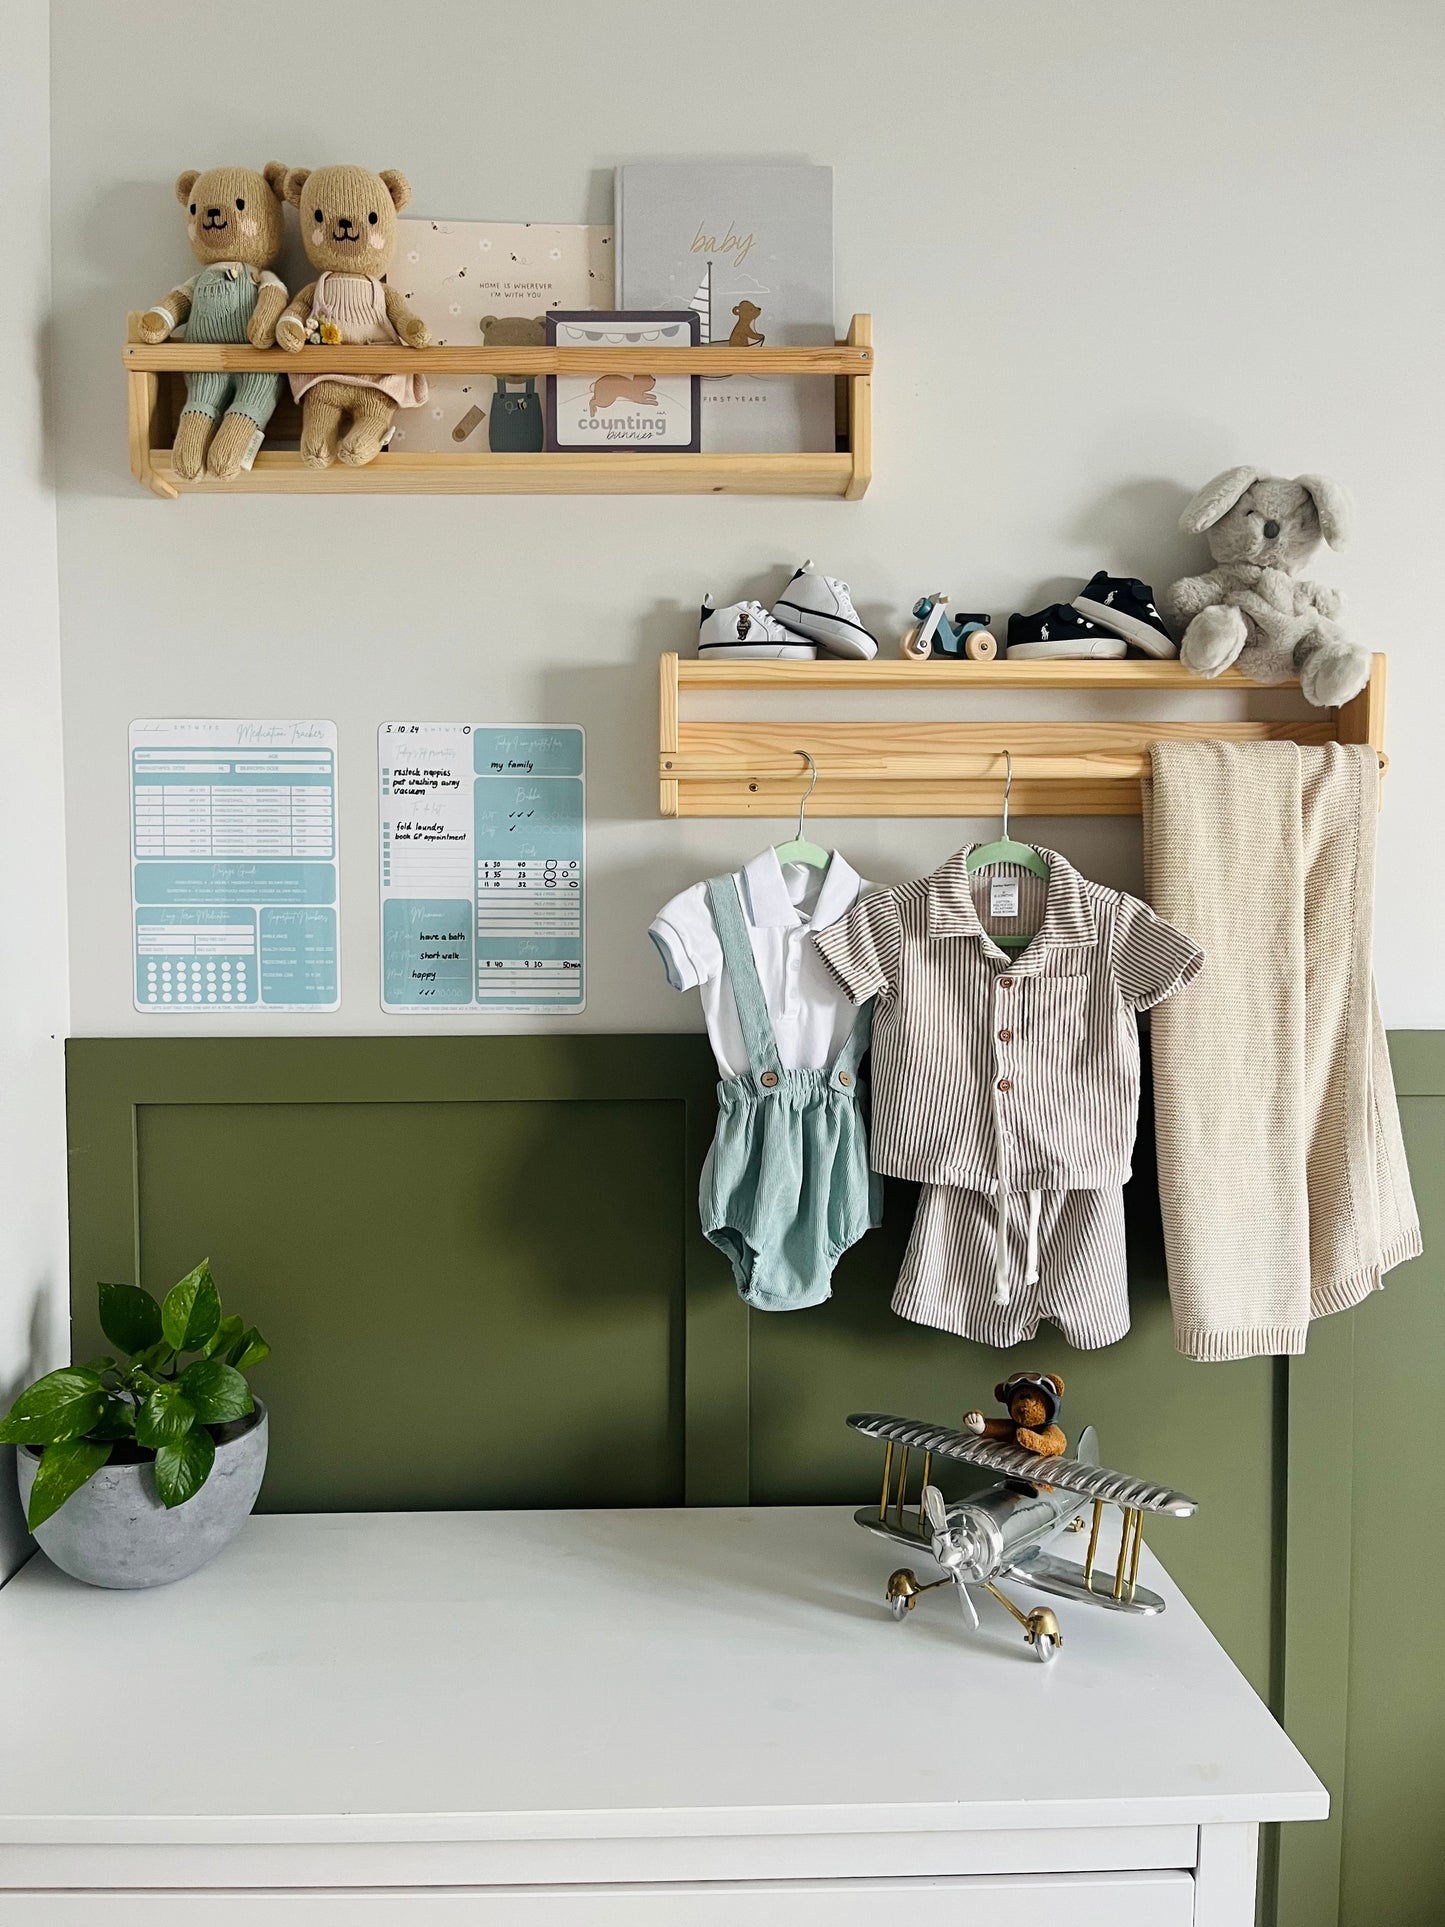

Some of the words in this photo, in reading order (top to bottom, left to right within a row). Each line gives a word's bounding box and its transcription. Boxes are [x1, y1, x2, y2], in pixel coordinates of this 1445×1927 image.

[689, 220, 756, 268] baby
[479, 282, 500, 290] HOME
[514, 282, 553, 290] WHEREVER
[527, 291, 542, 299] YOU
[703, 395, 731, 403] FIRST
[735, 395, 767, 403] YEARS
[577, 412, 667, 436] counting
[606, 421, 653, 440] bunnies
[236, 723, 287, 745] Medication
[288, 720, 325, 745] Tracker
[386, 724, 393, 733] 5
[410, 725, 420, 734] 24
[490, 761, 504, 773] my
[507, 760, 534, 773] family
[393, 767, 421, 777] restock
[423, 768, 451, 778] nappies
[392, 779, 407, 788] put
[408, 778, 438, 789] washing
[441, 780, 460, 789] away
[393, 788, 425, 796] vacuum
[396, 821, 412, 831] fold
[415, 822, 444, 834] laundry
[394, 833, 411, 841] book
[413, 833, 423, 841] GP
[424, 833, 467, 842] appointment
[493, 870, 502, 878] 35
[419, 931, 439, 941] have
[448, 932, 466, 941] bath
[419, 951, 441, 960] short
[442, 952, 460, 960] walk
[524, 960, 530, 968] 9
[412, 969, 437, 982] happy
